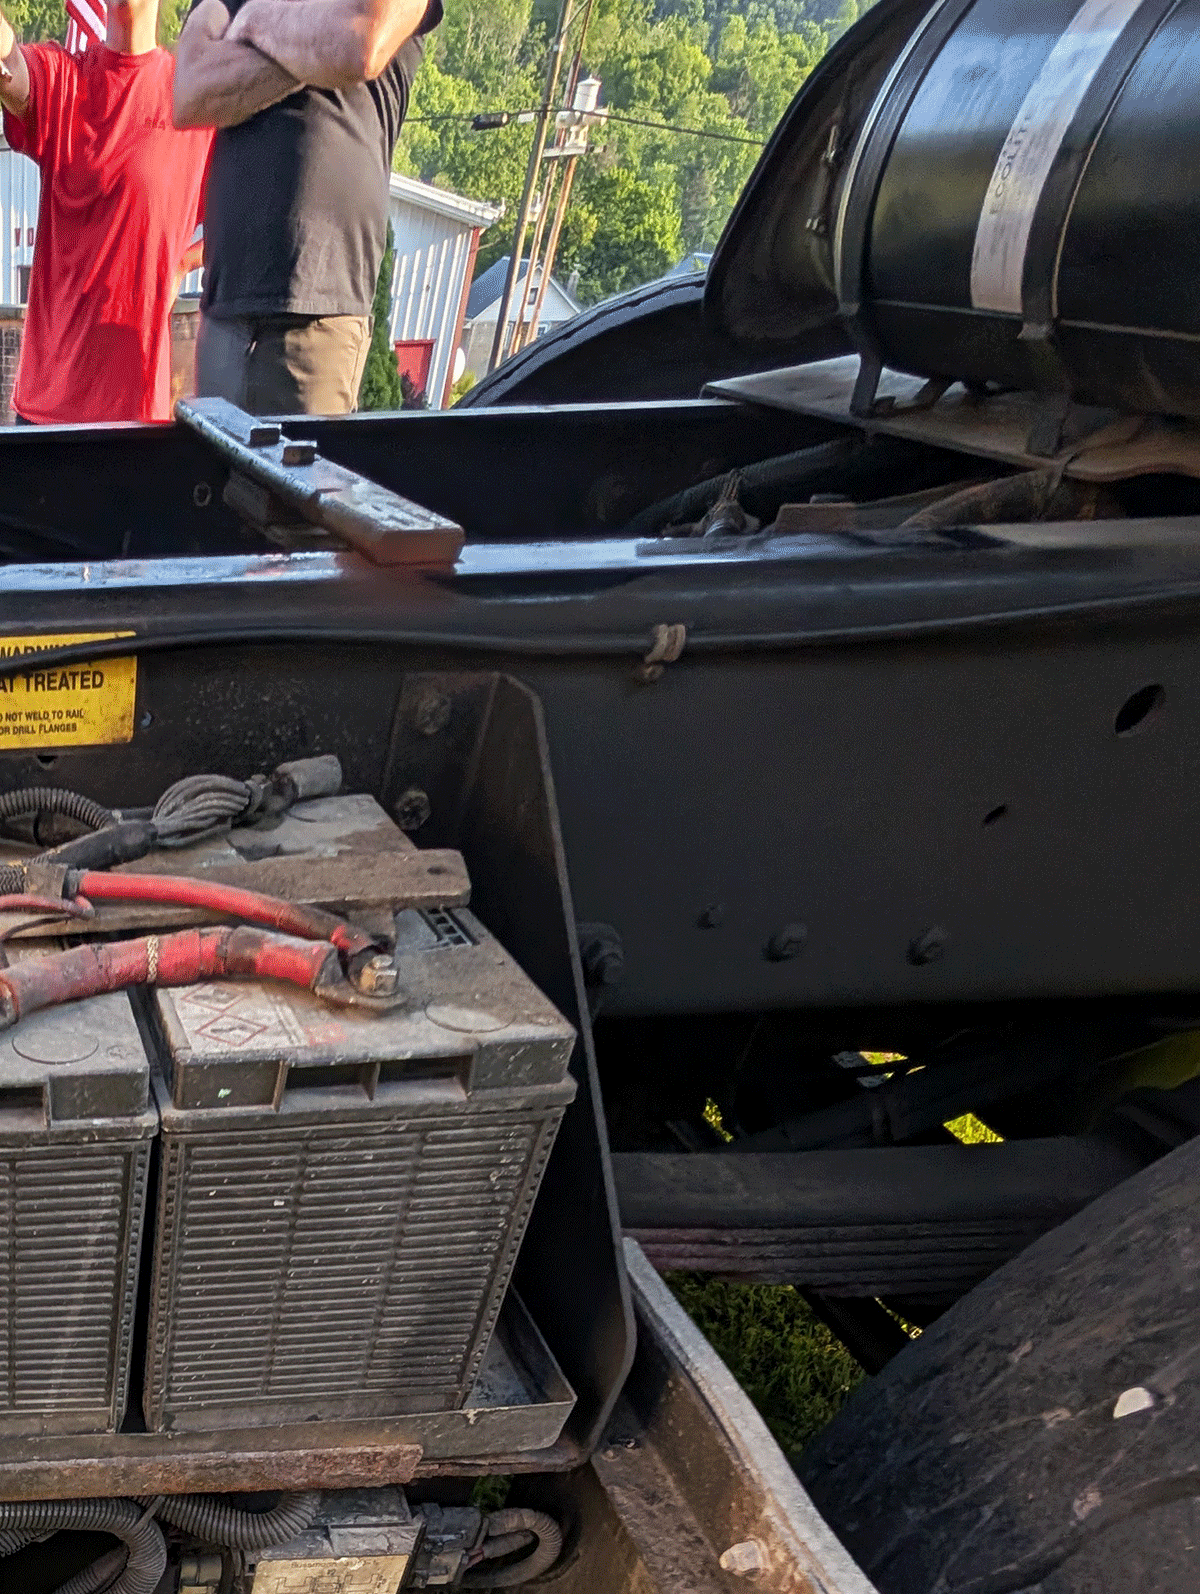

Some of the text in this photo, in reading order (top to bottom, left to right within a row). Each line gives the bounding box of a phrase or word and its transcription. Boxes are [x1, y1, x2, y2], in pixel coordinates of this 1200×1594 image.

[22, 670, 104, 692] TREATED
[5, 711, 23, 722] NOT
[25, 710, 50, 721] WELD
[52, 709, 64, 720] TO
[65, 708, 84, 719] RAIL
[12, 724, 36, 735] DRILL
[38, 722, 77, 734] FLANGES
